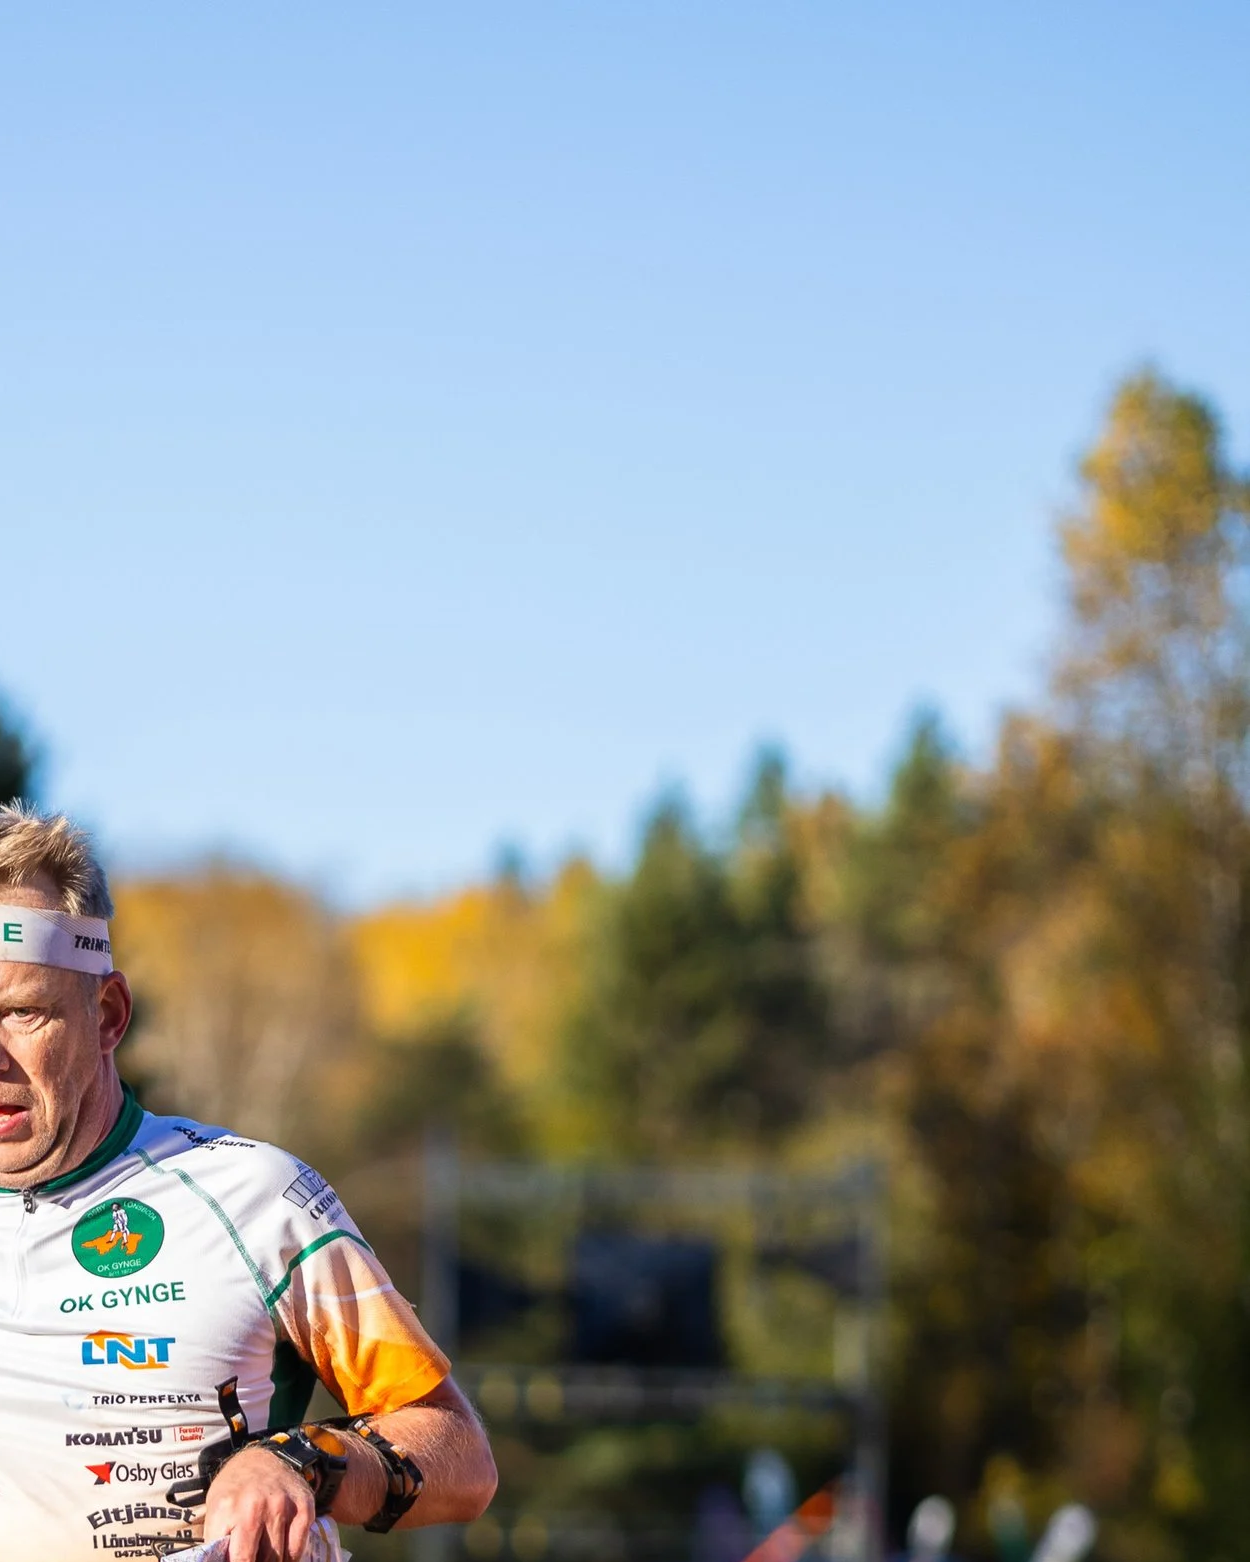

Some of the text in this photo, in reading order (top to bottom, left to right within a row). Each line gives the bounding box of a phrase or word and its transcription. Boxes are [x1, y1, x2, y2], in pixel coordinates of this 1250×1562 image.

[97, 1264, 110, 1273] OK
[111, 1258, 142, 1270] GYNGE
[60, 1281, 186, 1314] OK GYNGE
[82, 1337, 176, 1365] LNT
[92, 1394, 203, 1405] TRIO PERFEKTA
[65, 1427, 163, 1447] KOMATSU
[178, 1426, 204, 1435] Forestry
[115, 1460, 194, 1486] Osby Glas
[86, 1502, 197, 1530] Eltjänst
